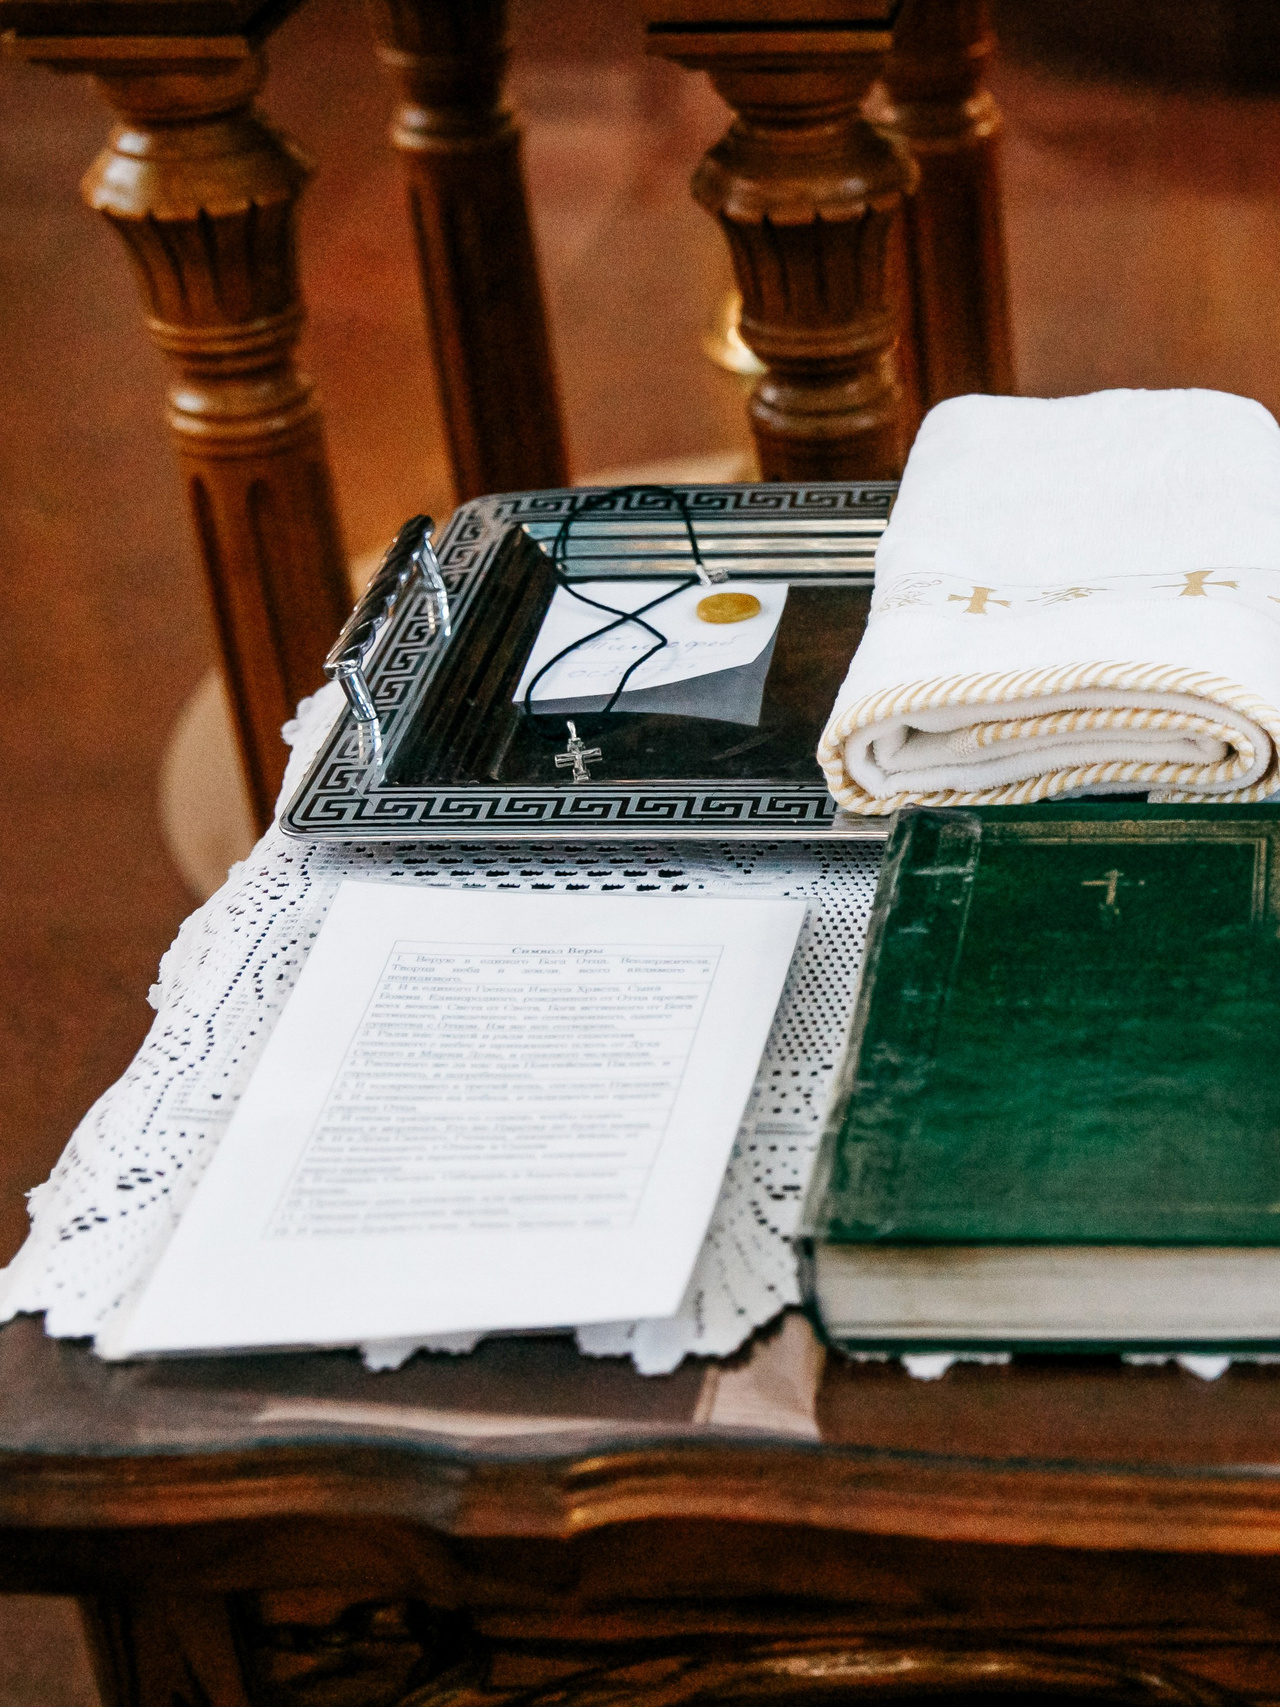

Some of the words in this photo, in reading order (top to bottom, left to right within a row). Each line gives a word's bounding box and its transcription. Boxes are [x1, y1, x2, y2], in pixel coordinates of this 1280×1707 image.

[511, 947, 563, 955] Символ
[567, 947, 604, 956] Веры
[416, 956, 455, 964] Верую
[392, 963, 435, 973] Творца
